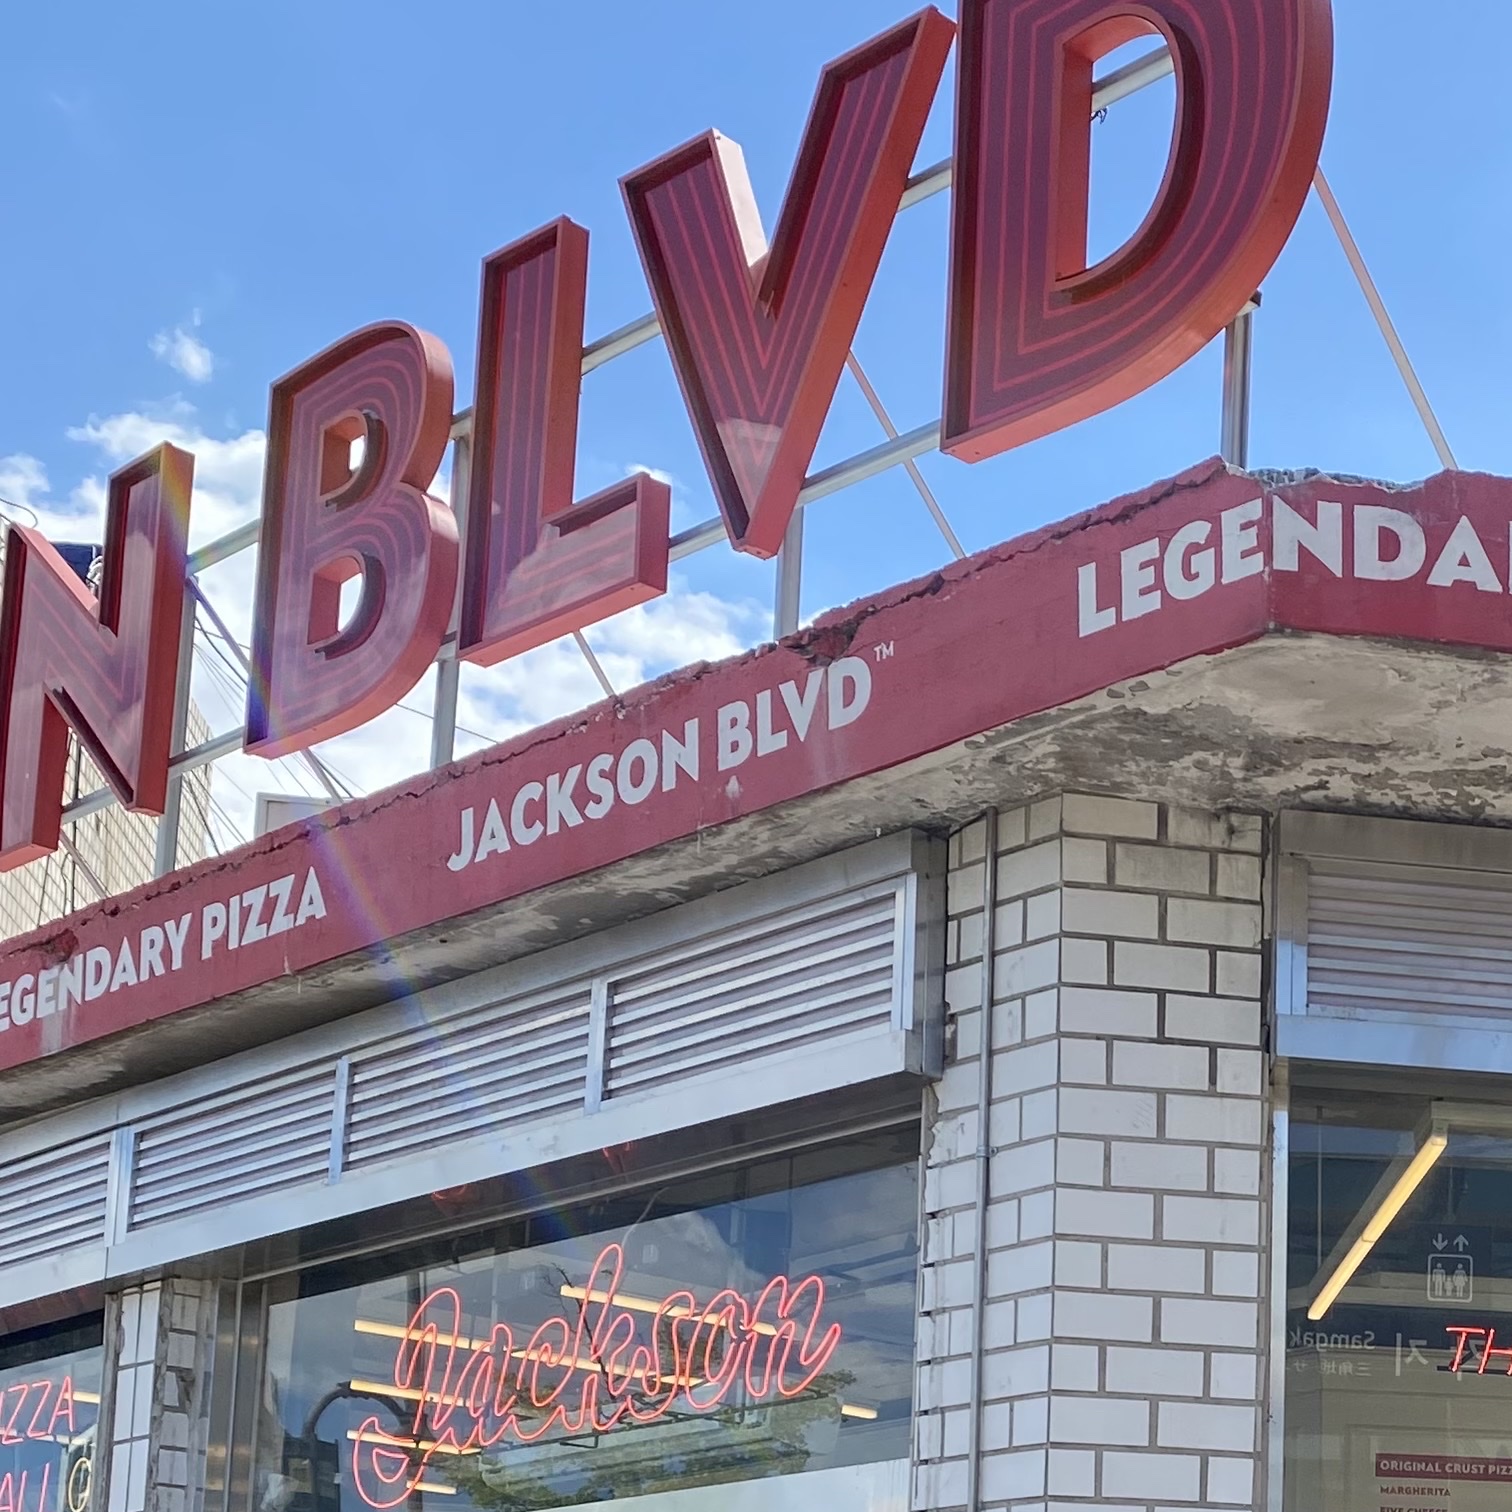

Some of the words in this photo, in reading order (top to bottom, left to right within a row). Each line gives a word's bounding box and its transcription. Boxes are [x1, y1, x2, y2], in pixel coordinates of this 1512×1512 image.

[243, 0, 1334, 759] BLVD
[446, 716, 699, 872] JACKSON
[716, 655, 873, 772] BLVD
[201, 866, 327, 961] PIZZA
[353, 1243, 842, 1509] Jackson
[1380, 1460, 1441, 1473] ORIGINAL
[1445, 1463, 1486, 1475] CRUST
[1380, 1485, 1451, 1497] MARGHERITA
